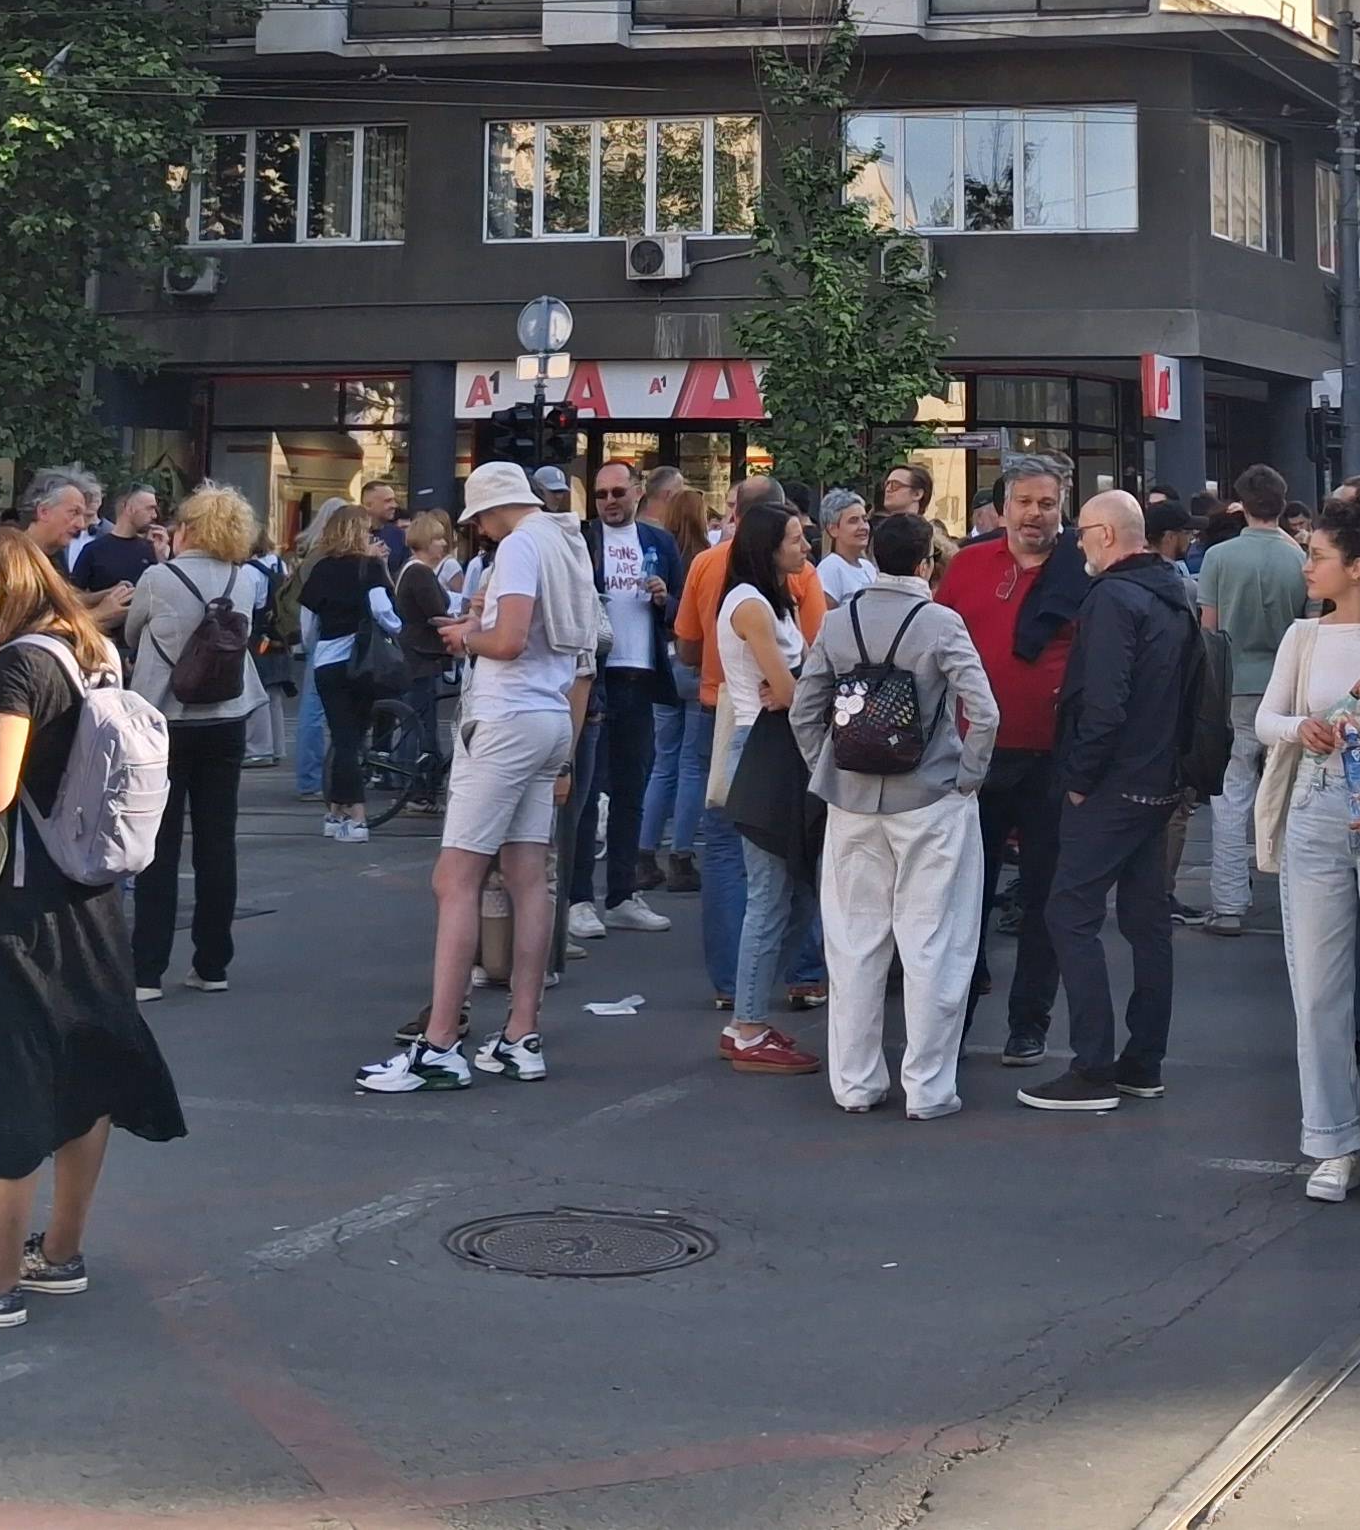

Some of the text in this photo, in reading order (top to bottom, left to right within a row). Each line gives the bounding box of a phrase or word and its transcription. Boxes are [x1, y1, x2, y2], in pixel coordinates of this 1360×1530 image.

[465, 370, 501, 409] A1
[649, 374, 667, 395] A1
[608, 545, 638, 561] SONS
[616, 562, 638, 576] ARE
